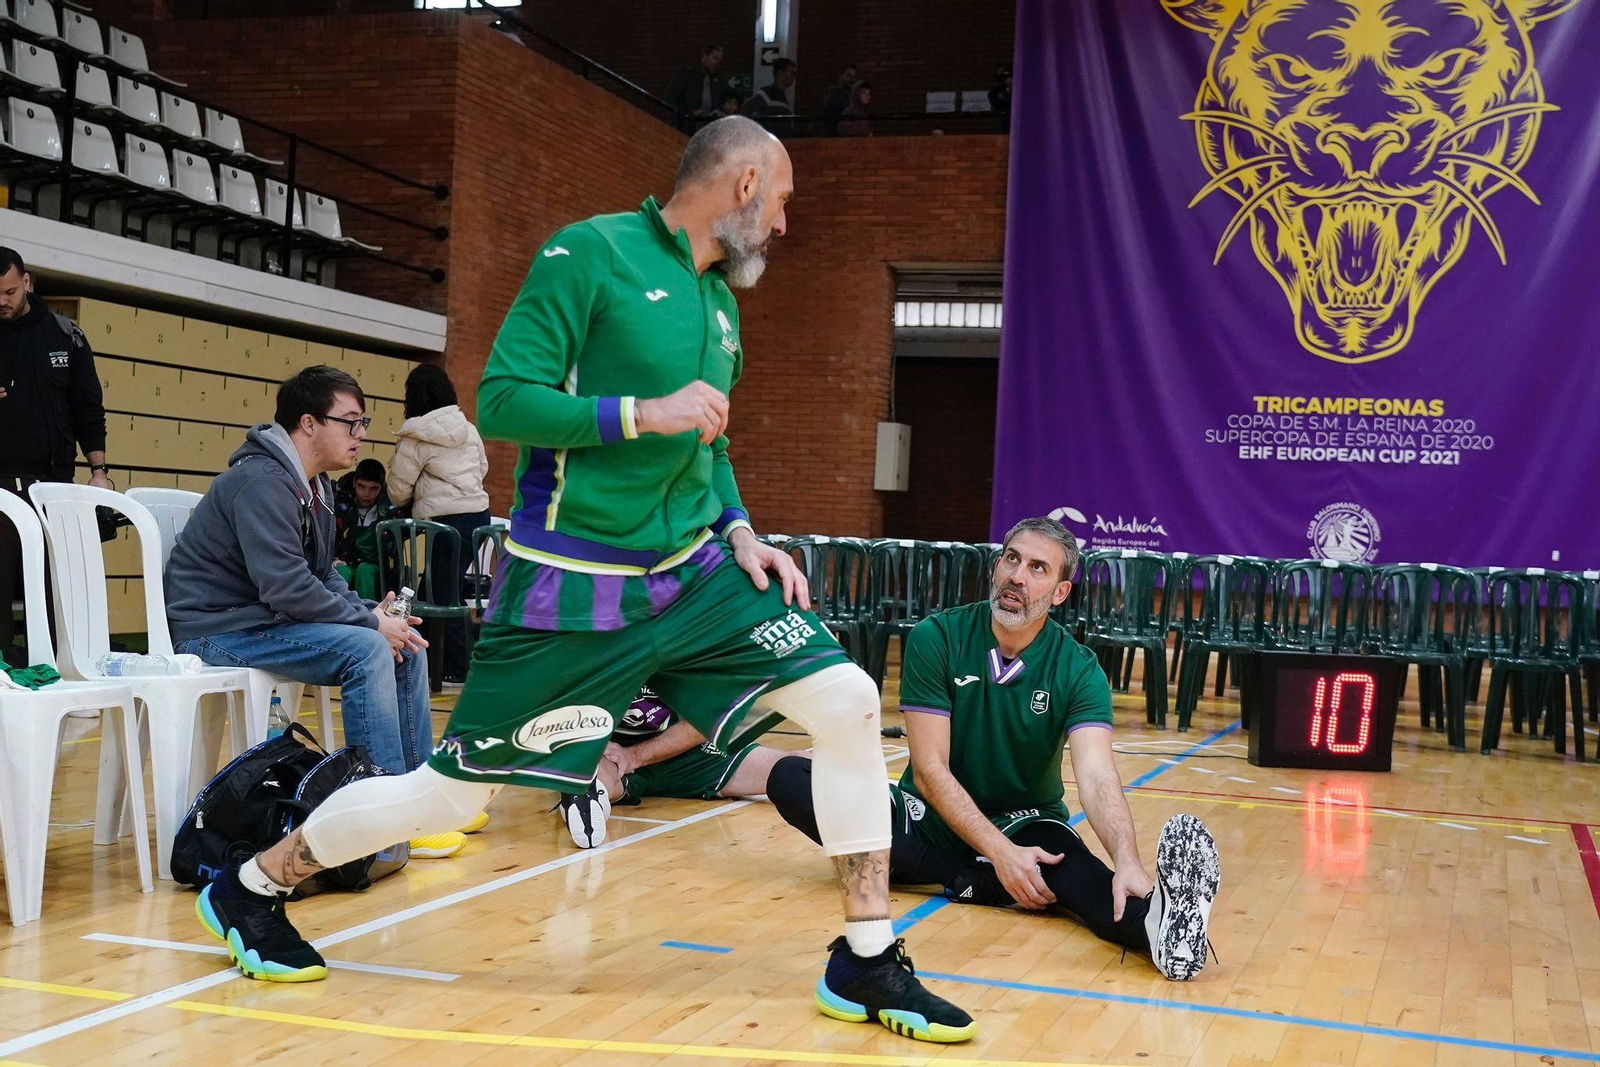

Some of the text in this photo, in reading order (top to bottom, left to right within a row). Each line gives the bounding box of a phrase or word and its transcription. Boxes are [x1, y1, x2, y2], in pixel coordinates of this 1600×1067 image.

[1253, 395, 1445, 417] TRICAMPEONAS
[1227, 414, 1476, 434] COPA DE S.M. LA REINA 2020
[1204, 429, 1495, 450] SUPERCOPA DE ESPAÑA DE 2020
[1238, 446, 1460, 465] EHF EUROPEAN CUP 2021
[1309, 672, 1375, 754] 10
[521, 708, 609, 744] famadesa
